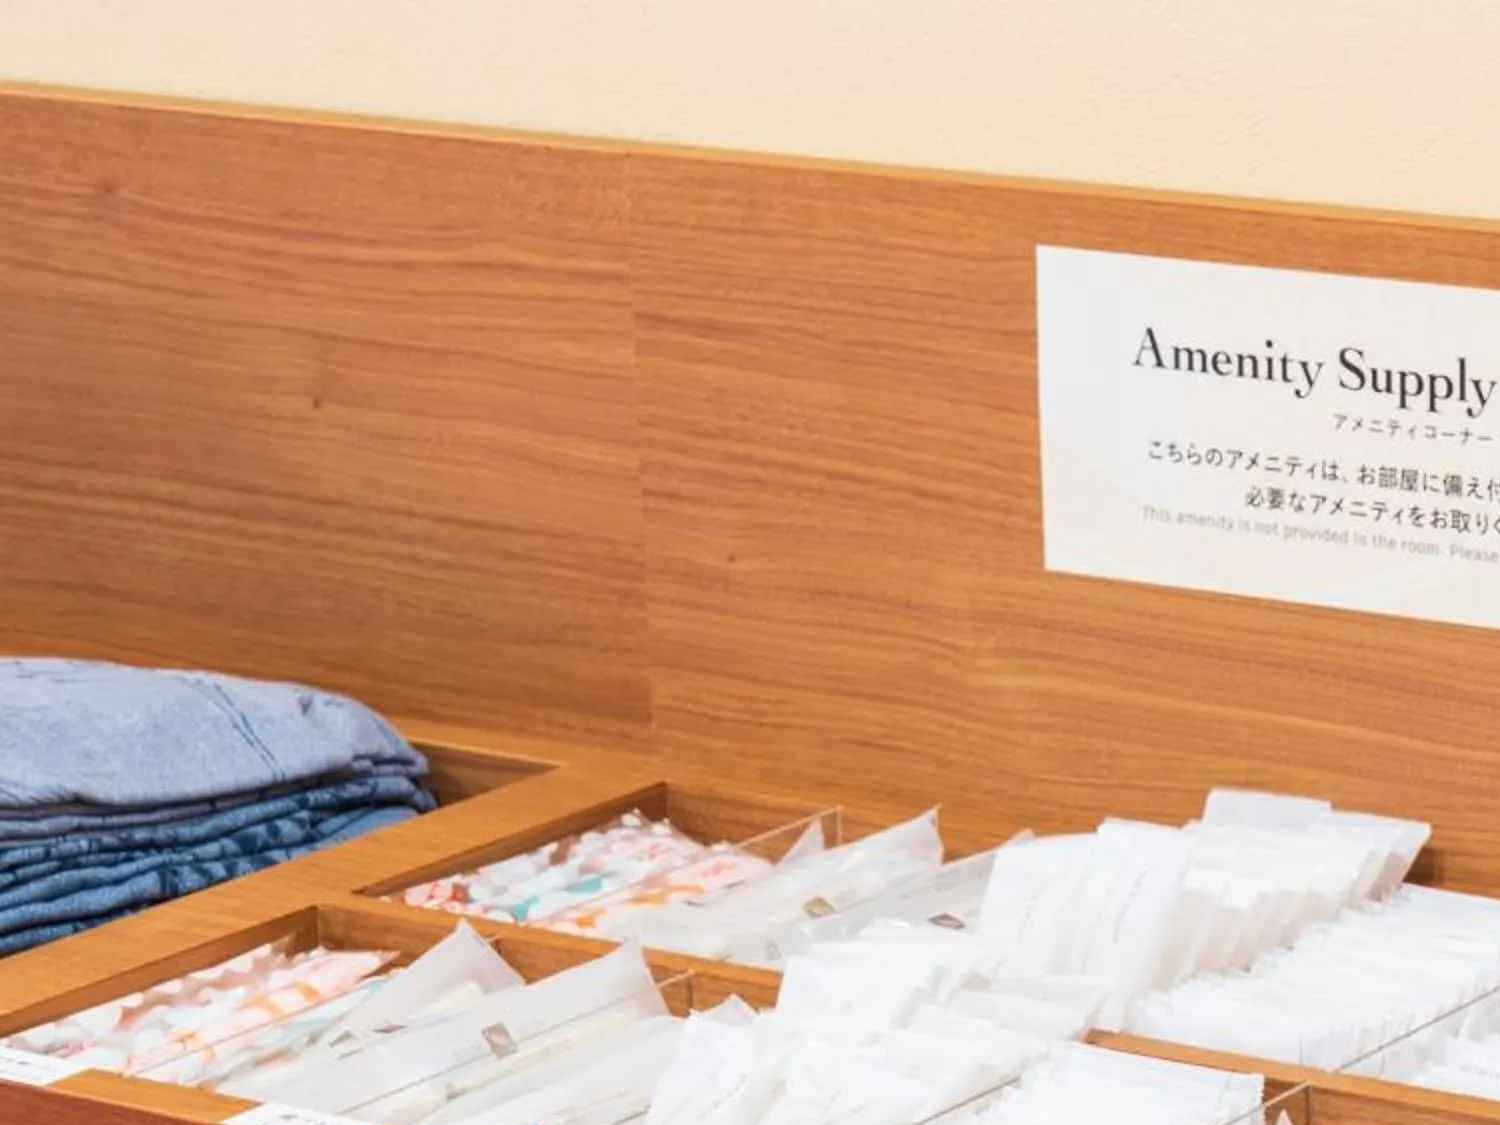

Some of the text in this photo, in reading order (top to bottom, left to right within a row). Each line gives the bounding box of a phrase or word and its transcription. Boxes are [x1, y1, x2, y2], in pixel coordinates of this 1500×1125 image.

[1132, 326, 1325, 399] Amenity
[1338, 347, 1496, 418] Supply
[1333, 413, 1494, 445] アメニティコーナー
[1142, 505, 1171, 523] This
[1176, 510, 1234, 532] amenity
[1237, 516, 1251, 534] is
[1255, 519, 1280, 536] not
[1283, 523, 1349, 547] provided
[1353, 531, 1367, 547] in
[1371, 534, 1397, 550] the
[1450, 544, 1499, 564] Please
